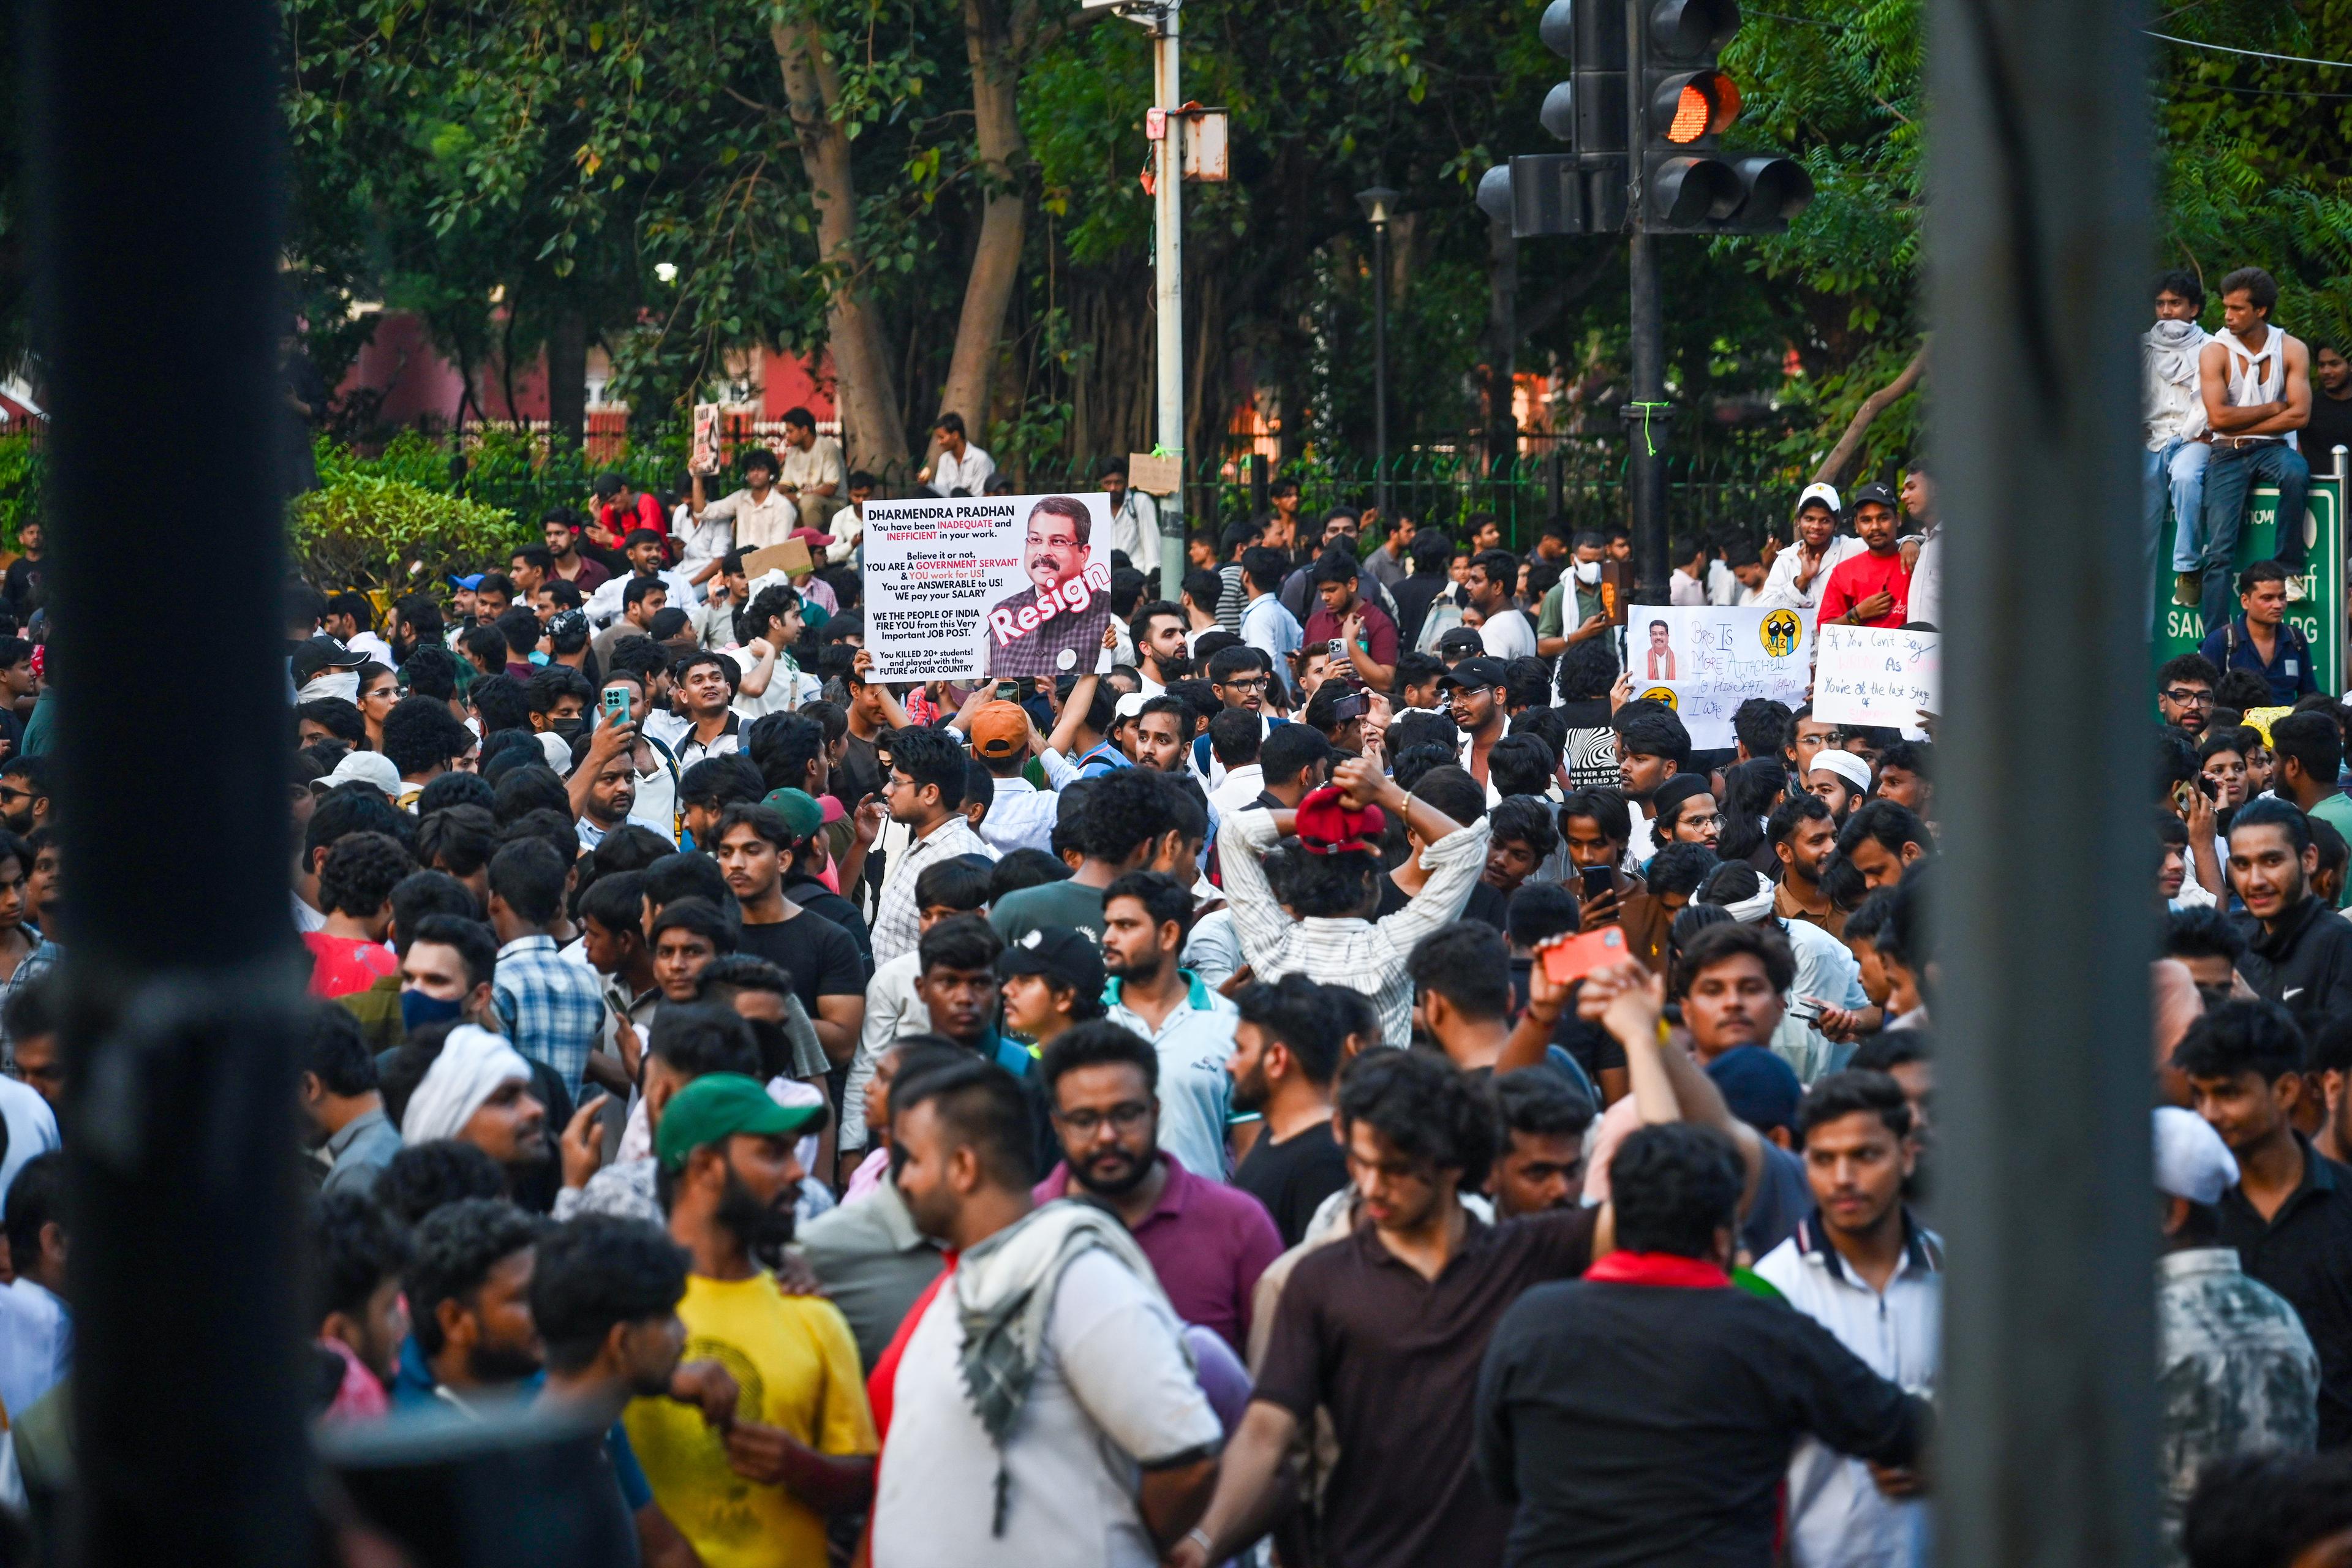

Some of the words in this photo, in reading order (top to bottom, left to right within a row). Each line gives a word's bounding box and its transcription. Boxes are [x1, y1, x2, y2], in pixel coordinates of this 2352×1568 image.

[869, 508, 953, 520] DHARMENDRA
[957, 505, 1014, 518] PRADHAN
[938, 520, 992, 529] INADEQUATE
[888, 532, 937, 541] INEFFICIENT
[916, 560, 977, 570] GOVERNMENT
[979, 559, 1018, 568] SERVANT
[931, 570, 952, 579] work
[918, 580, 975, 589] ANSWERABLE
[911, 593, 927, 601] pay
[930, 592, 949, 601] your
[952, 589, 986, 598] SALARY
[988, 562, 1111, 646] Resign
[907, 610, 939, 619] PEOPLE
[956, 609, 979, 617] INDIA
[957, 619, 976, 628] Very
[882, 631, 925, 641] Important
[1848, 629, 1861, 647] You
[1903, 633, 1936, 663] Say
[907, 658, 932, 668] played
[1871, 681, 1885, 695] the
[1889, 682, 1904, 696] last
